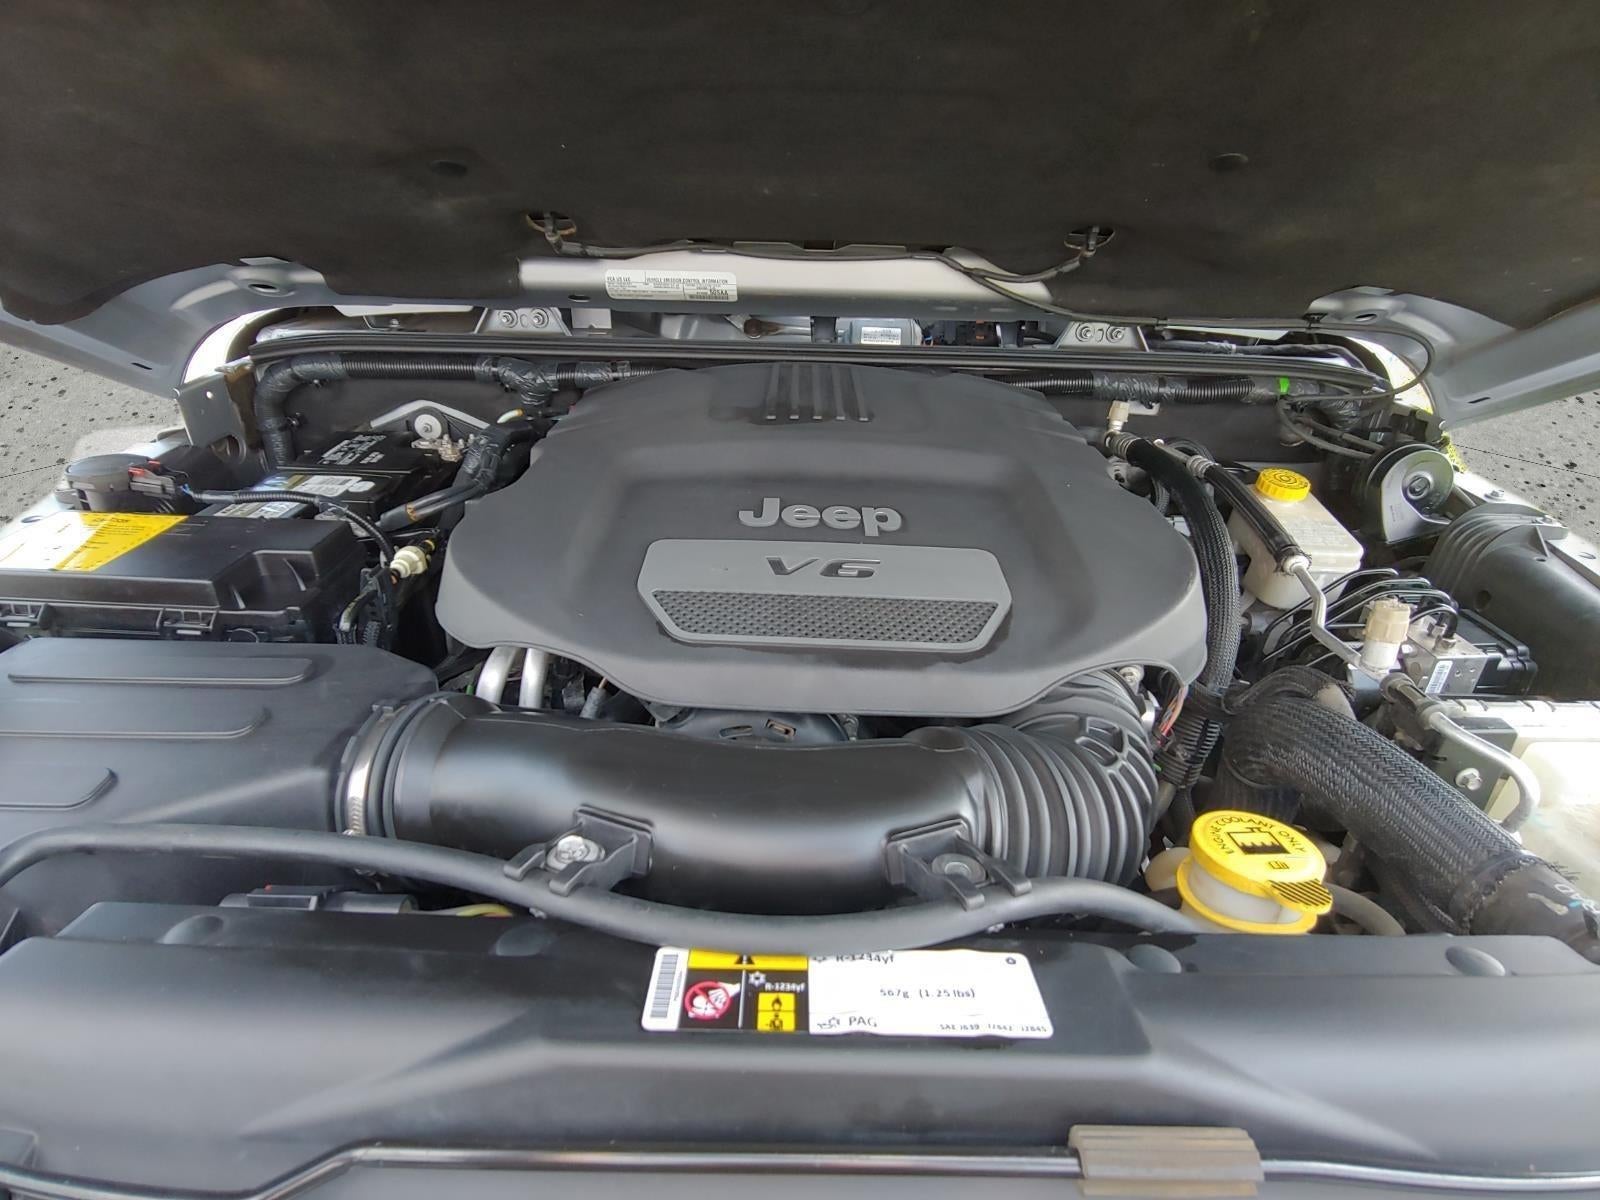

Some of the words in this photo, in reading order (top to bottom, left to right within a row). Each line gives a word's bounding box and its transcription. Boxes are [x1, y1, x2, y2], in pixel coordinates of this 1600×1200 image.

[738, 496, 903, 537] Jeep
[766, 556, 881, 578] V6
[1215, 816, 1276, 831] COOLANT
[1278, 831, 1306, 854] ONLY
[849, 1016, 878, 1028] PAG
